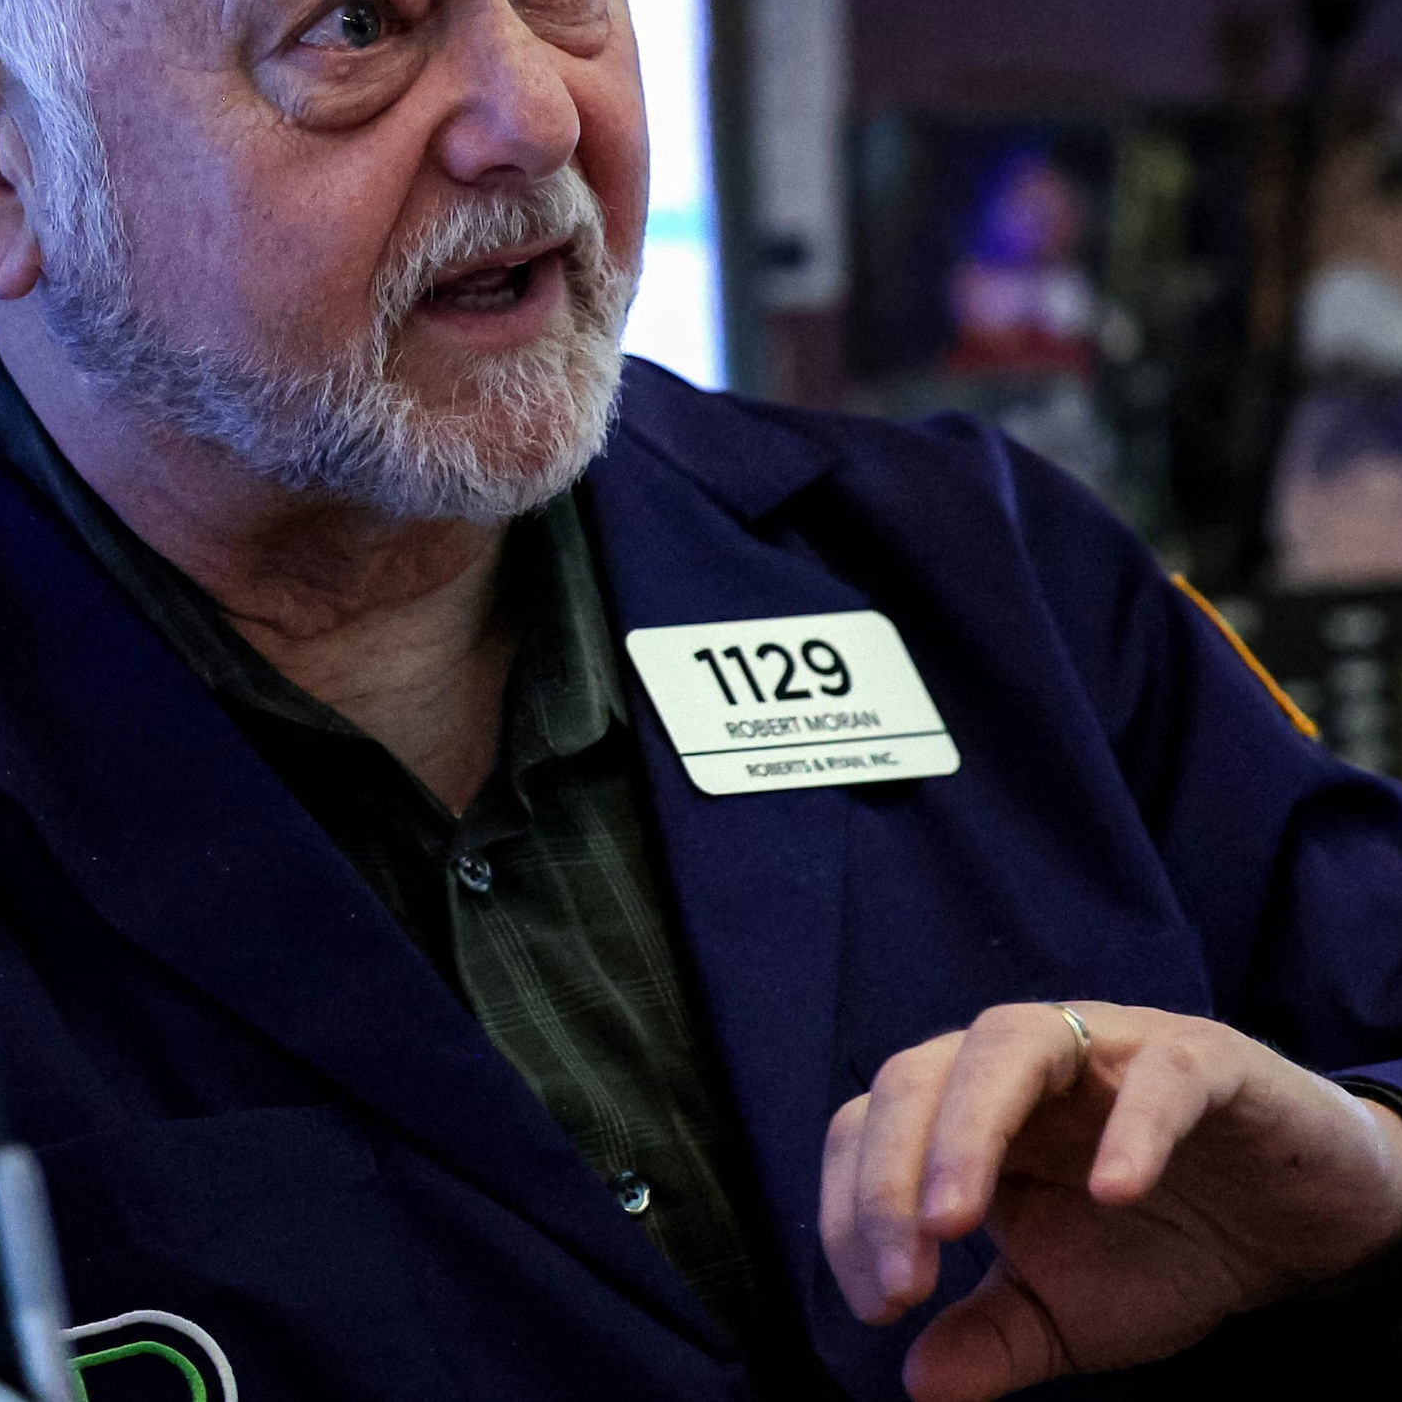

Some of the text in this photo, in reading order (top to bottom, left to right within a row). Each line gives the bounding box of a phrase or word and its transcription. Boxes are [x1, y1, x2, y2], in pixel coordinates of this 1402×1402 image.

[694, 639, 852, 705] 1129
[726, 710, 881, 739] ROBERT MORAN
[746, 760, 812, 777] ROBERTS
